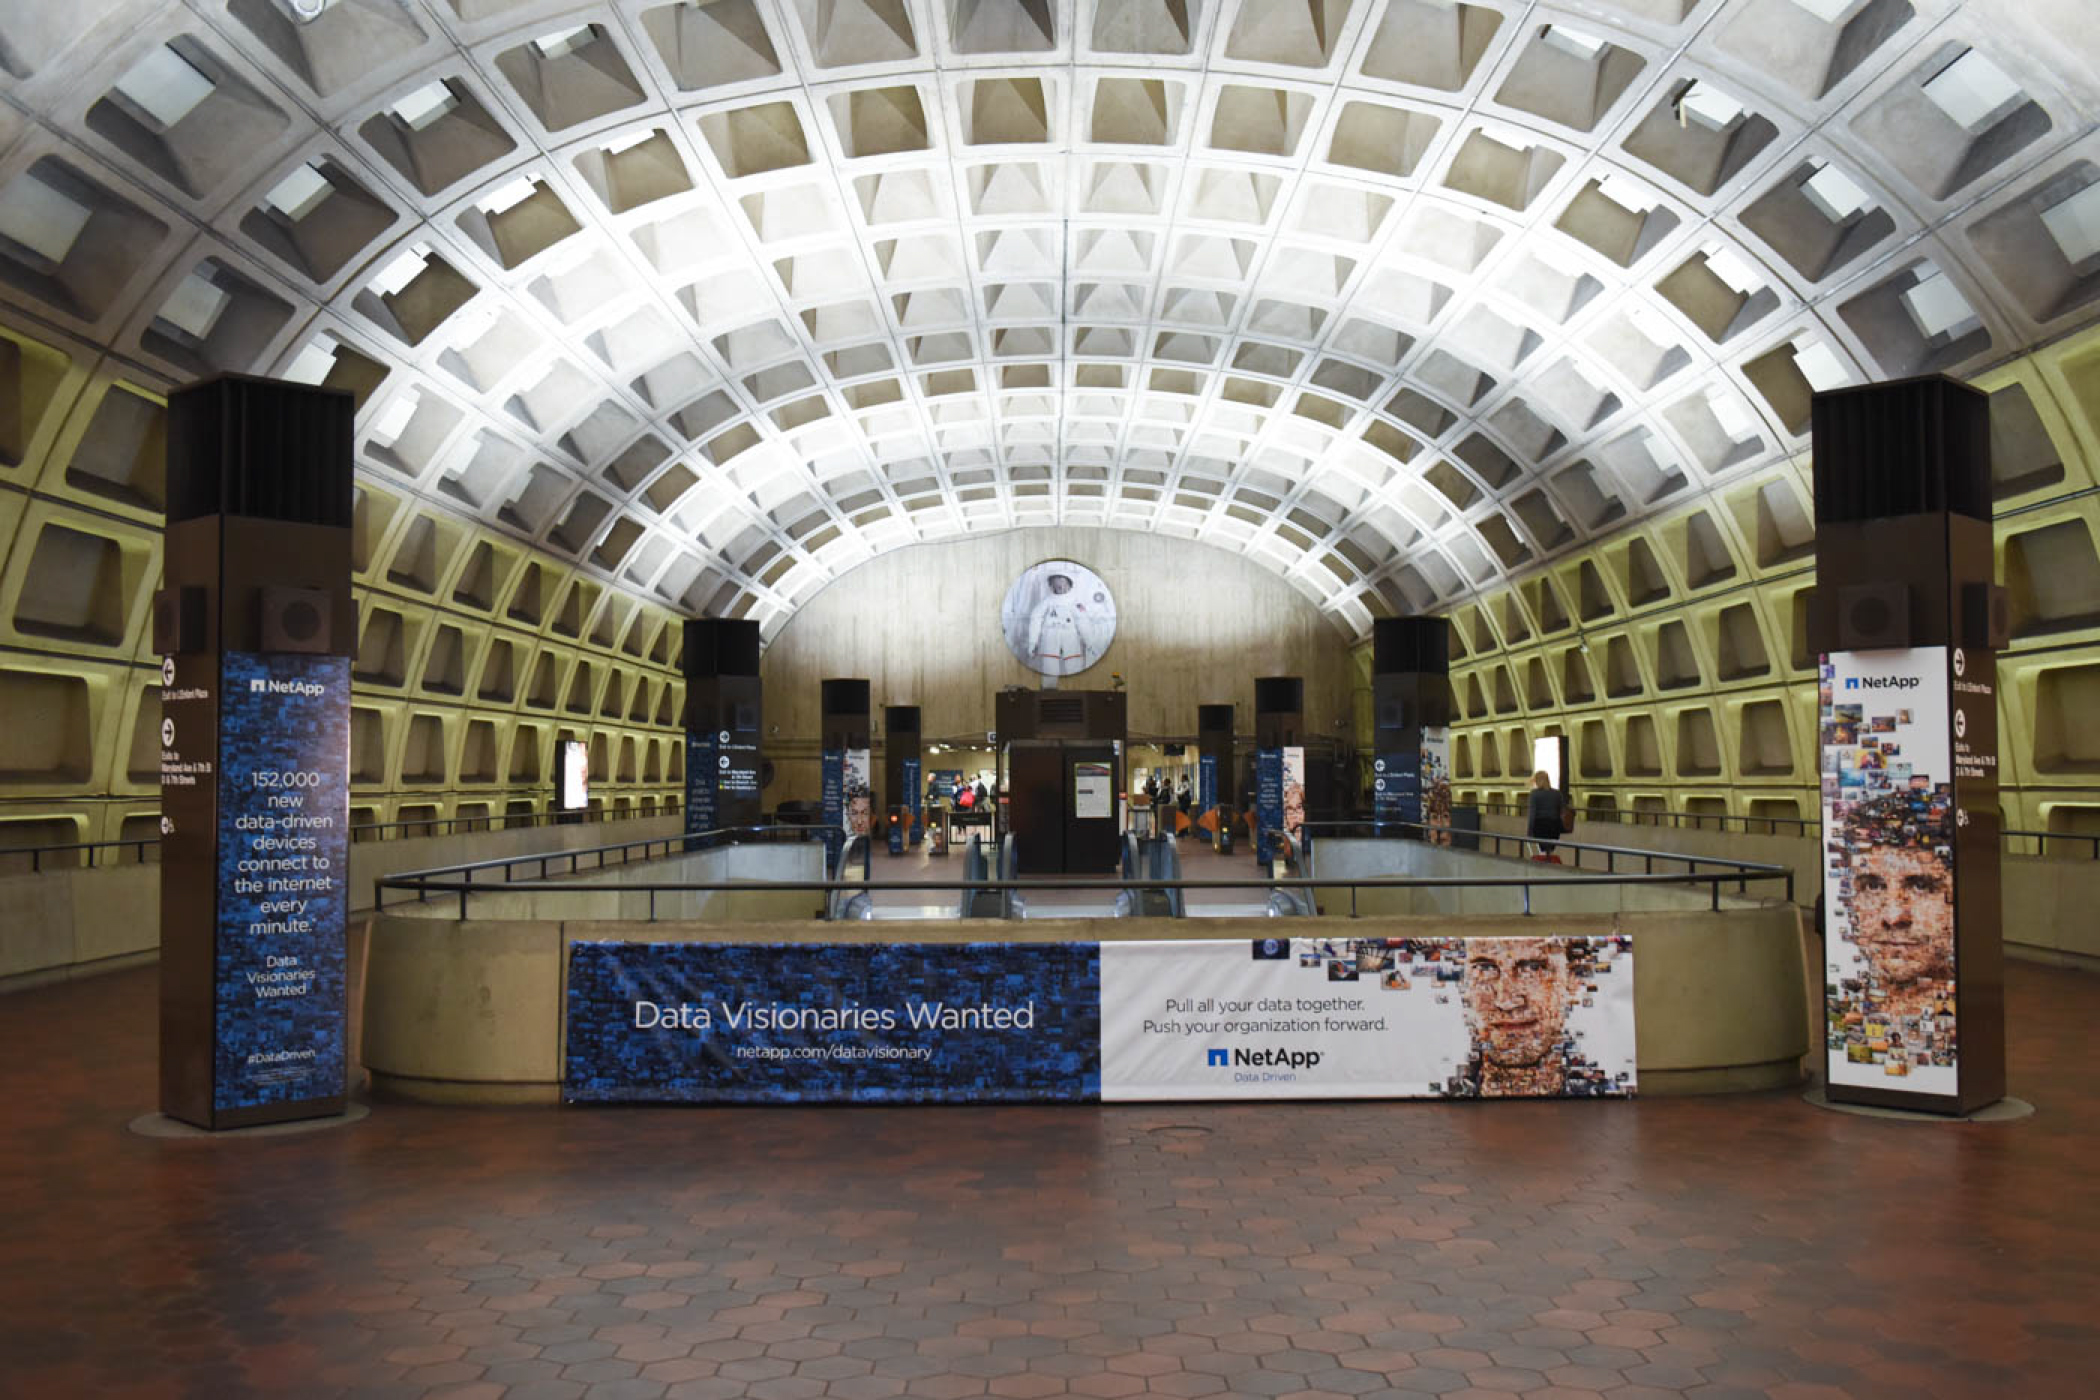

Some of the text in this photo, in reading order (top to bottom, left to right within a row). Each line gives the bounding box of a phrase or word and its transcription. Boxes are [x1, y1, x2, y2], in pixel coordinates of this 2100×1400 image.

[267, 681, 325, 697] NetApp
[1862, 675, 1920, 690] NetApp
[251, 772, 320, 788] 152,000
[268, 795, 304, 808] new
[235, 815, 333, 830] data-driven
[253, 835, 316, 850] devices
[238, 855, 330, 873] connect to
[234, 876, 332, 893] the internet
[260, 900, 308, 914] every
[266, 955, 298, 968] Data
[246, 969, 316, 984] Visionaries
[255, 984, 307, 998] Wanted
[1166, 998, 1365, 1015] Pull all your data together.
[635, 1000, 1034, 1030] Data Visionaries Wanted
[1143, 1017, 1389, 1036] Push your organization forward.
[247, 1048, 316, 1065] #DataDriven
[736, 1044, 933, 1062] netapp.com/datavisionary
[1234, 1048, 1321, 1069] NetApp
[1234, 1072, 1297, 1083] Data Driven
